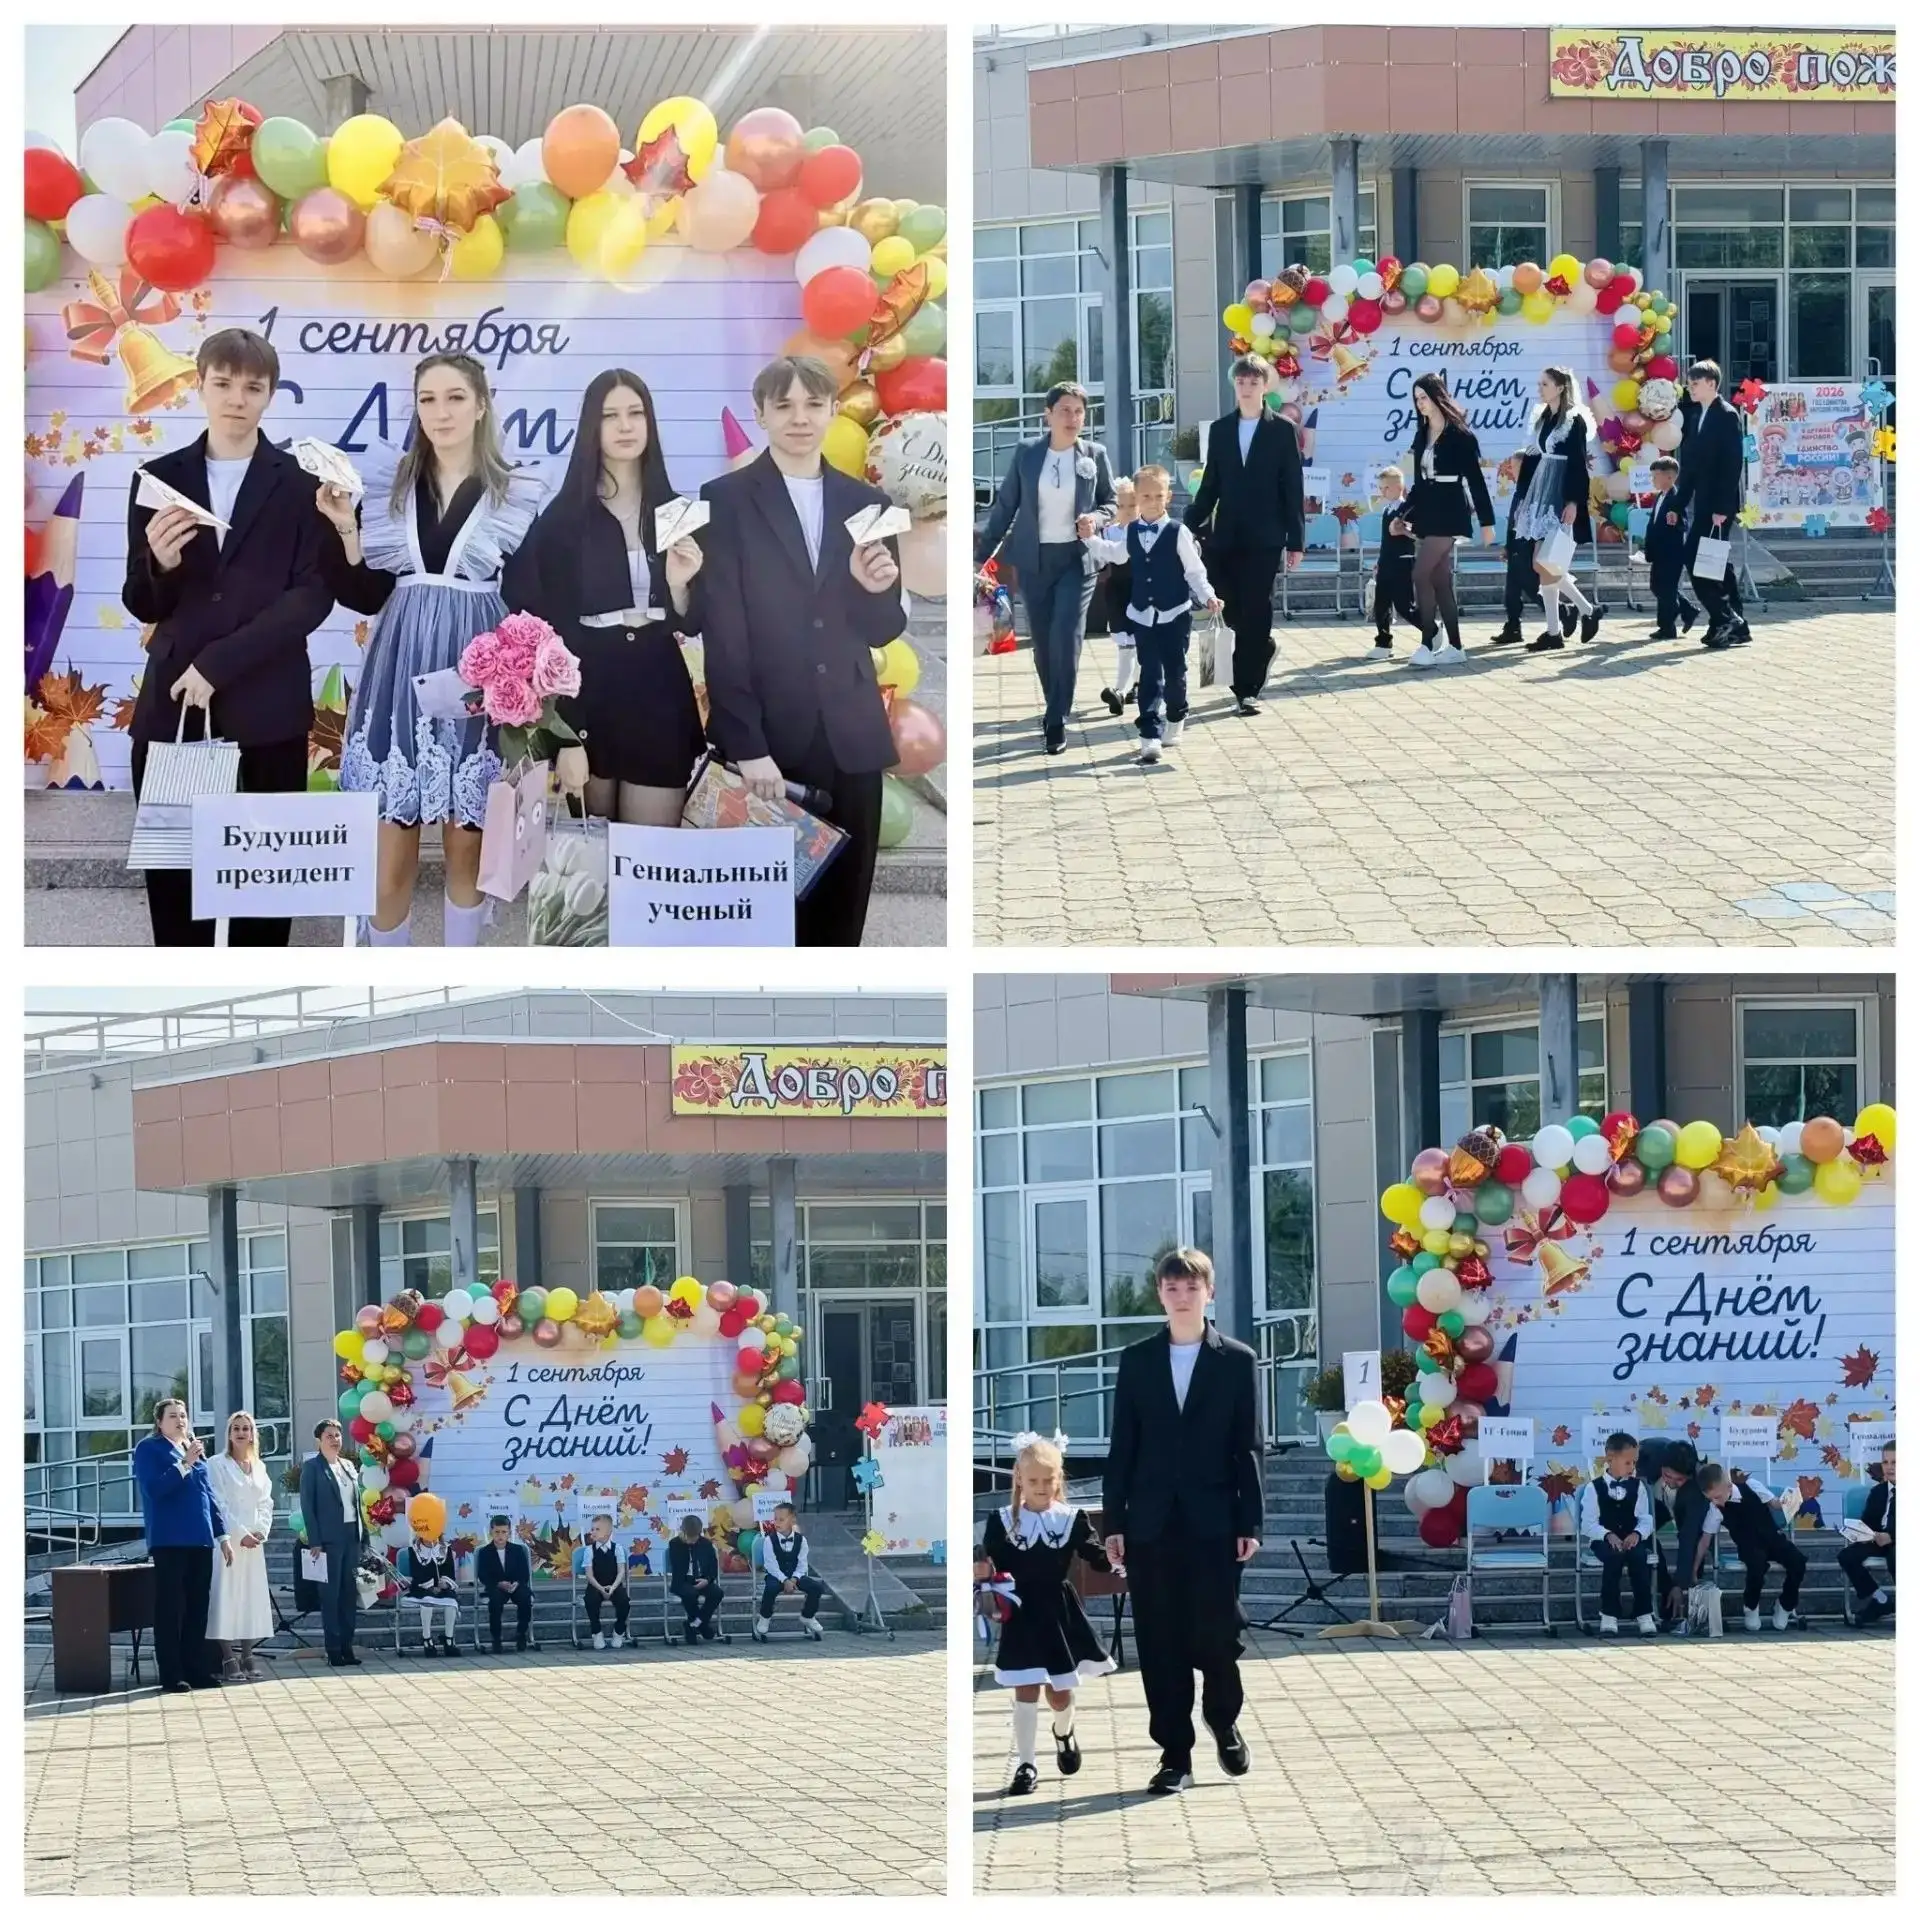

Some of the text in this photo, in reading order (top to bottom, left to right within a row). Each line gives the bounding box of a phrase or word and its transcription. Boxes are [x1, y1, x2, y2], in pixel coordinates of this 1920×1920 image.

[1606, 36, 1896, 97] Добро пож
[258, 306, 569, 370] 1 сентября
[1389, 336, 1524, 362] 1 сентября
[1386, 367, 1412, 400] С
[1815, 386, 1845, 397] 2026
[334, 381, 576, 455] Дм
[1384, 398, 1529, 442] зний!
[902, 430, 922, 456] С
[223, 824, 348, 852] Будущий
[216, 865, 355, 889] президент
[612, 854, 789, 884] Гениальный
[648, 898, 752, 923] ученый
[730, 1053, 898, 1115] Добро
[1620, 1224, 1816, 1263] 1 сентября
[1616, 1272, 1822, 1326] С Днём
[1612, 1313, 1826, 1380] знаний!
[507, 1360, 645, 1388] 1 сентября
[1358, 1360, 1370, 1384] 1
[504, 1394, 649, 1433] С Днём
[502, 1424, 652, 1471] знаний!
